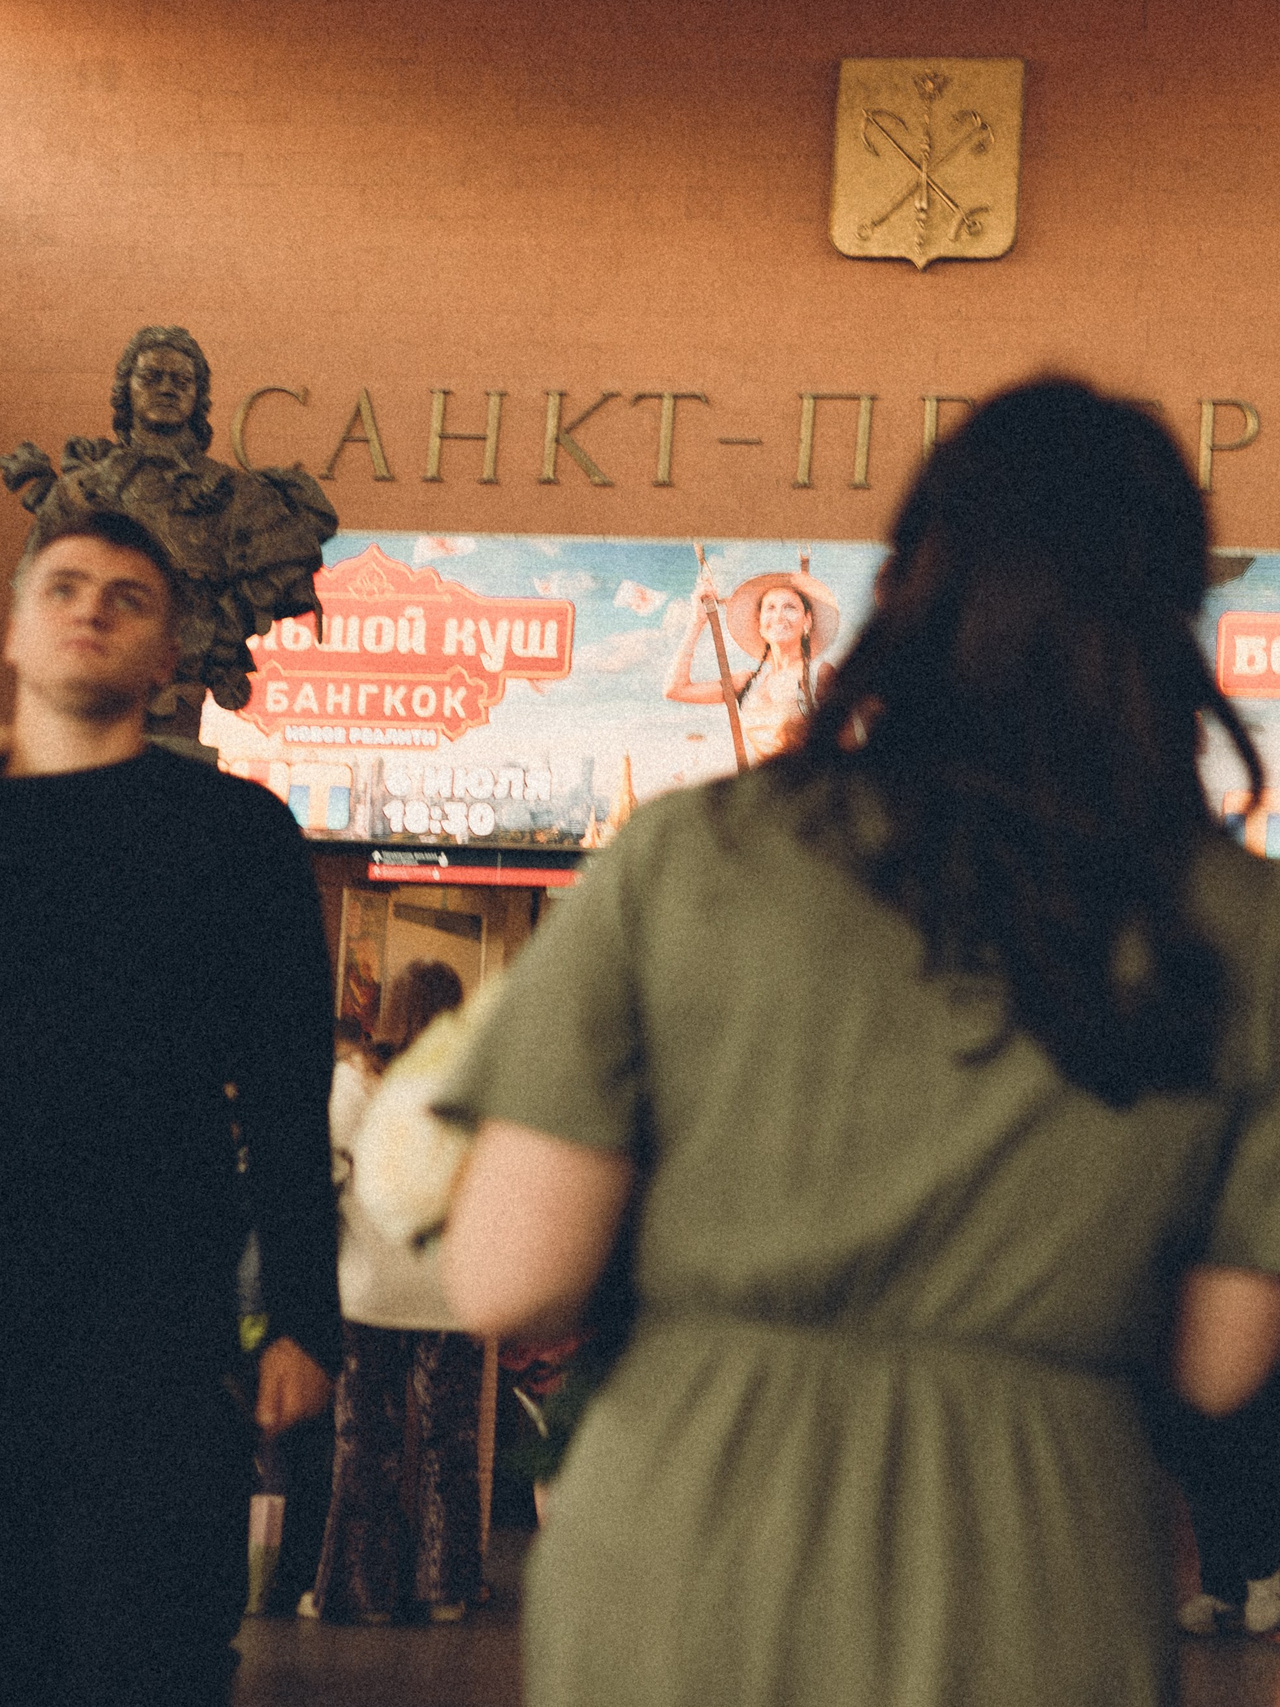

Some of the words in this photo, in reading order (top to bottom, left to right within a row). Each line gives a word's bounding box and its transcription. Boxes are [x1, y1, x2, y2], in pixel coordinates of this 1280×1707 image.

[265, 680, 467, 719] БАНГКОК
[285, 724, 347, 744] НОВОЕ
[349, 726, 437, 746] РЕАЛИТИ
[422, 766, 551, 800] ИЮЛЯ
[383, 799, 495, 836] 18:30
